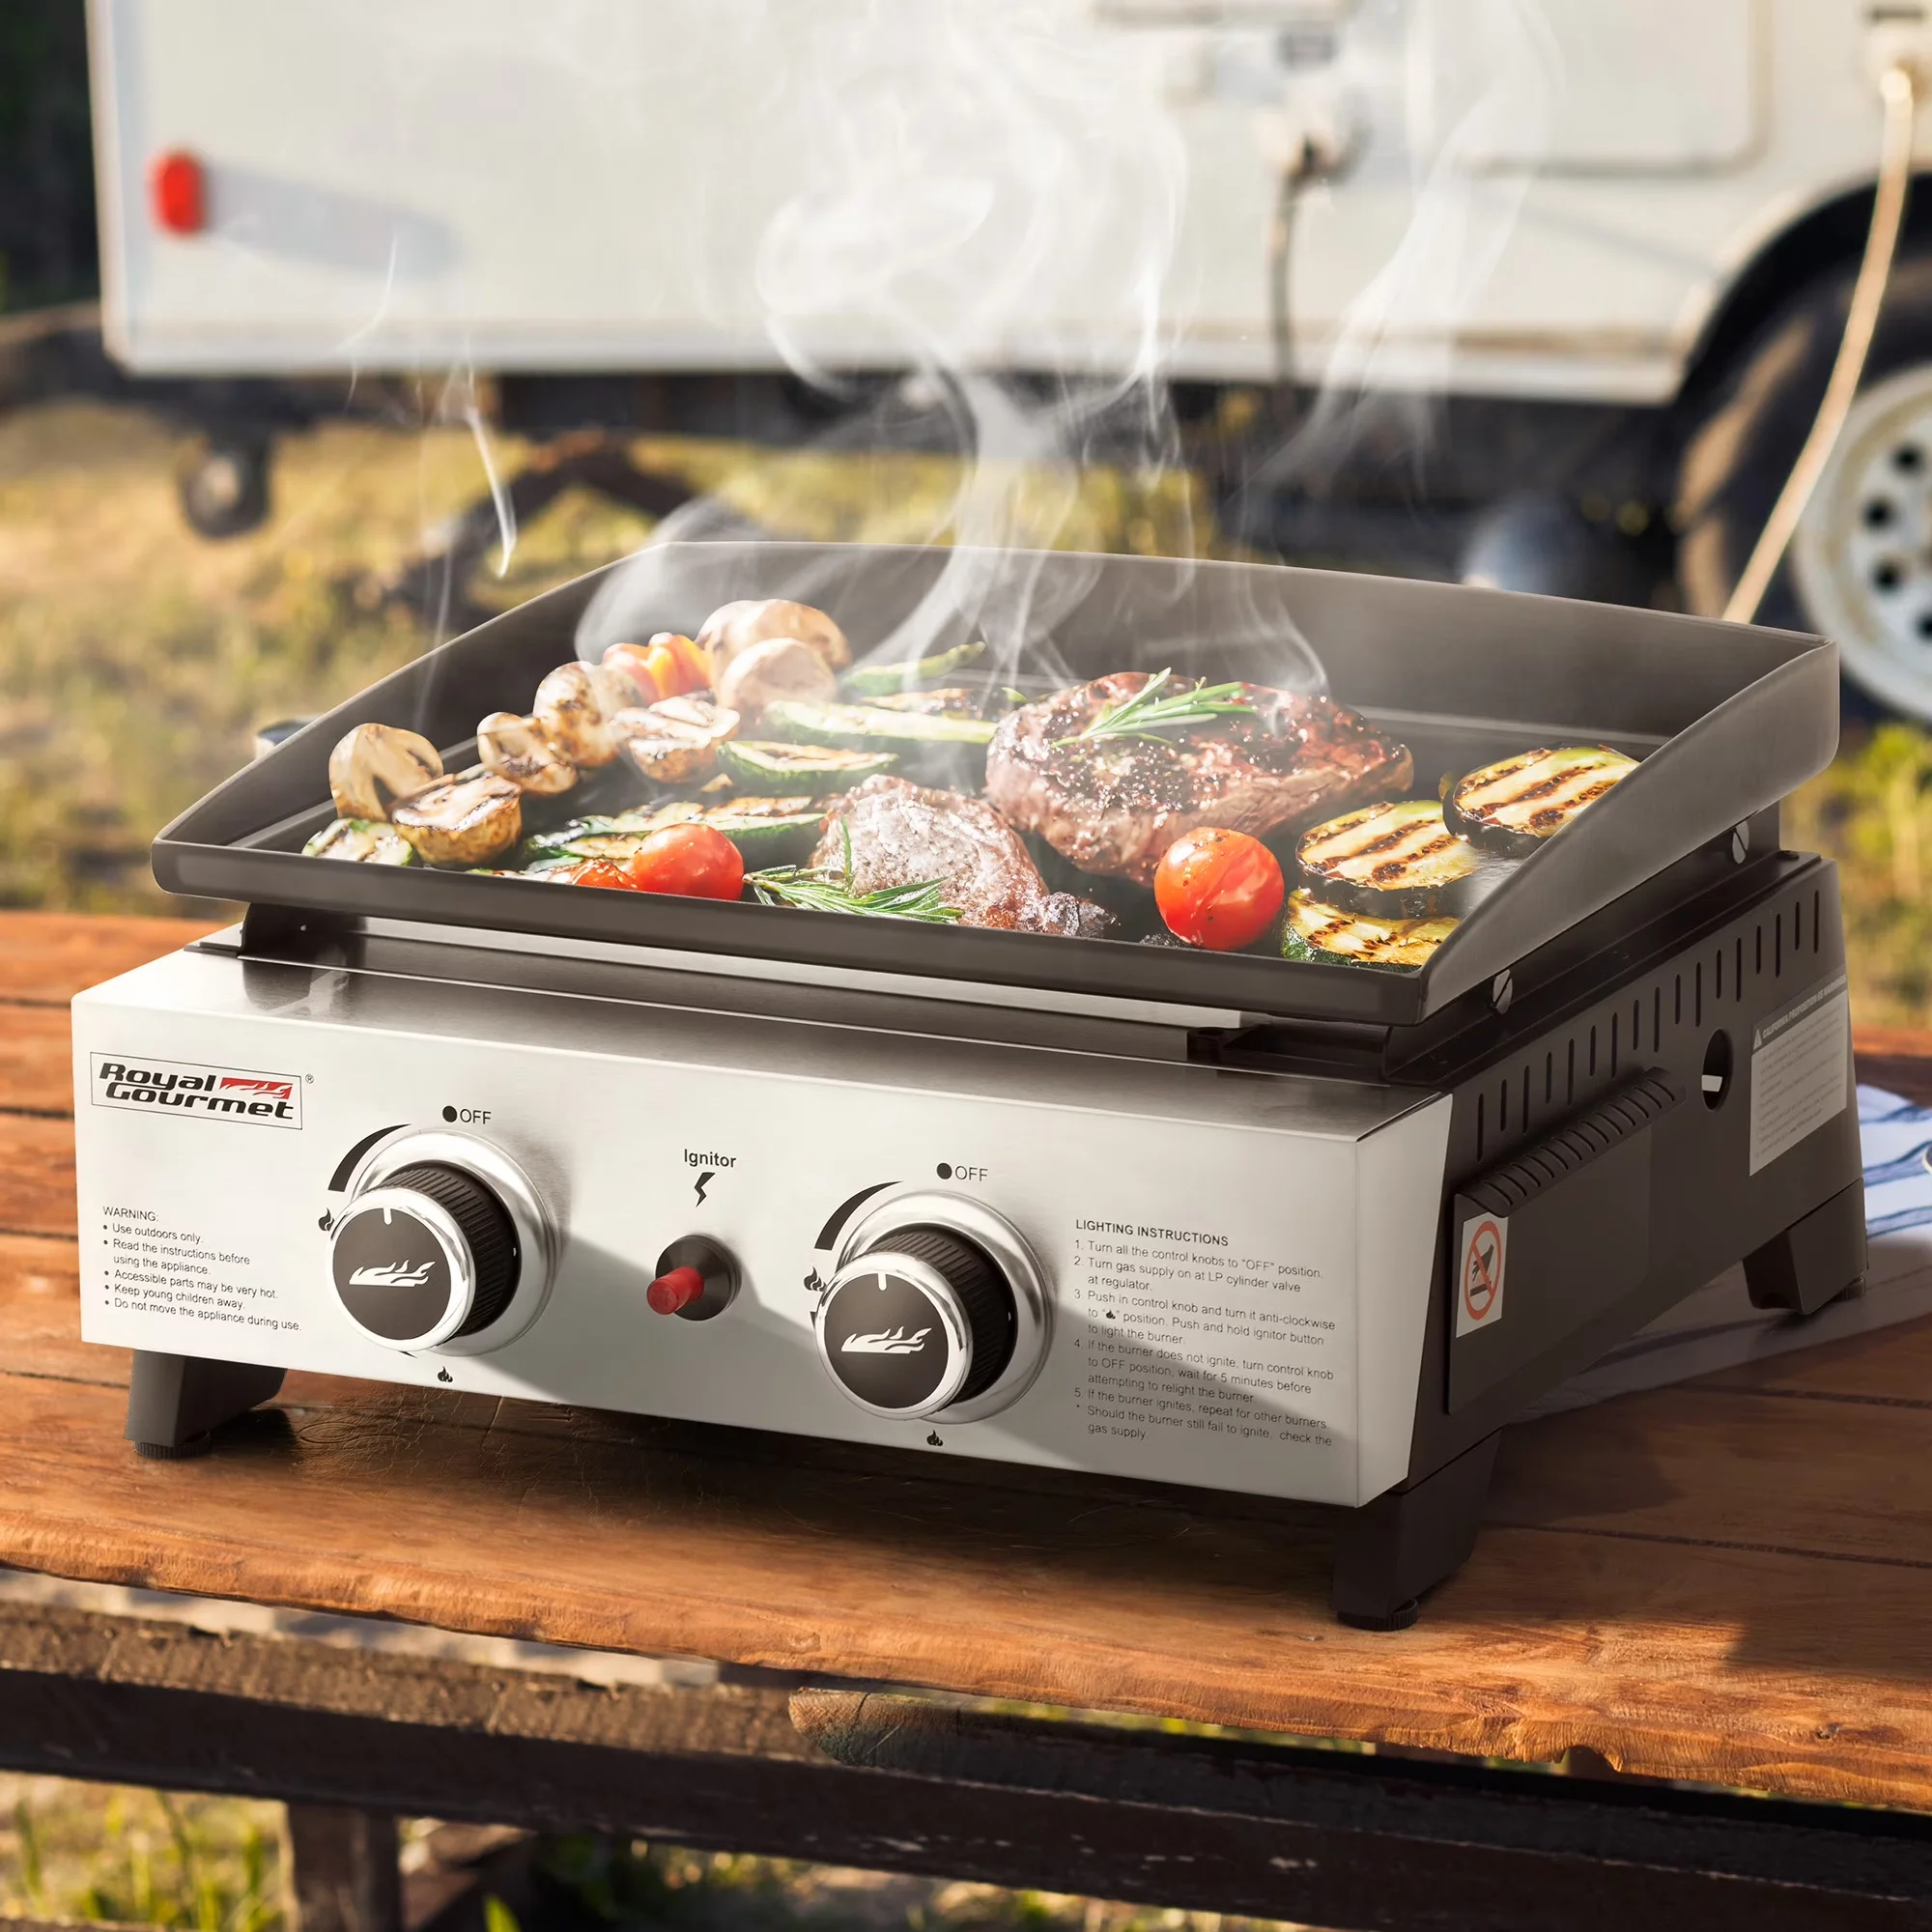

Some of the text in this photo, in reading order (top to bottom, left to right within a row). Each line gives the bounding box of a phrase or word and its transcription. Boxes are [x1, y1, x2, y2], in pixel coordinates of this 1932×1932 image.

[99, 1063, 216, 1092] Royal
[106, 1082, 294, 1120] Gourmet
[460, 1109, 492, 1124] OFF
[684, 1149, 736, 1168] Ignitor
[954, 1165, 988, 1181] OFF
[102, 1207, 158, 1221] WARNING:
[112, 1223, 203, 1244] Use outdoors only.
[1076, 1219, 1229, 1246] LIGHTING INSTRUCTIONS
[113, 1238, 250, 1264] Read the instructions before
[1088, 1240, 1113, 1253] Turn
[1117, 1244, 1128, 1255] all
[1132, 1246, 1148, 1257] the
[1152, 1250, 1188, 1262] control
[1192, 1253, 1225, 1266] knobs
[1228, 1258, 1237, 1267] to
[1242, 1259, 1275, 1271] "OFF"
[1278, 1264, 1322, 1278] position.
[113, 1256, 211, 1275] using the appliance.
[1088, 1257, 1113, 1269] Turn
[1116, 1263, 1135, 1273] gas
[1140, 1265, 1175, 1279] supply
[1178, 1269, 1191, 1279] on
[1195, 1271, 1205, 1281] at
[1208, 1271, 1223, 1282] LP
[1227, 1275, 1268, 1287] cylinder
[1272, 1281, 1300, 1293] valve
[114, 1269, 278, 1298] Accessible parts may be very hot.
[1088, 1275, 1152, 1292] at regulator.
[114, 1284, 245, 1311] Keep young children away.
[1088, 1290, 1115, 1303] Push
[1119, 1293, 1128, 1304] in
[1132, 1298, 1168, 1309] control
[1172, 1301, 1198, 1313] knob
[1202, 1306, 1221, 1316] and
[1225, 1308, 1246, 1319] turn
[1250, 1310, 1256, 1321] it
[1260, 1313, 1335, 1330] anti-clockwise
[114, 1298, 301, 1331] Do not move the appliance during use.
[1088, 1308, 1324, 1345] to position. Push and hold ignitor button
[1088, 1324, 1186, 1345] to light the burner.
[1088, 1340, 1095, 1350] If
[1097, 1341, 1115, 1352] the
[1118, 1345, 1153, 1357] burner
[1156, 1349, 1183, 1361] does
[1186, 1352, 1204, 1364] not
[1242, 1360, 1264, 1371] turn
[1267, 1364, 1304, 1376] control
[1307, 1367, 1333, 1379] knob
[1088, 1357, 1098, 1367] to
[1101, 1358, 1125, 1369] OFF
[1179, 1369, 1200, 1379] wait
[1203, 1370, 1217, 1381] for
[1221, 1373, 1228, 1383] 5
[1231, 1376, 1273, 1389] minutes
[1277, 1380, 1312, 1394] before
[1088, 1374, 1145, 1391] attempting
[1149, 1381, 1158, 1391] to
[1162, 1383, 1198, 1396] relight
[1199, 1387, 1215, 1398] the
[1088, 1389, 1095, 1399] If
[1097, 1391, 1115, 1402] the
[1118, 1393, 1153, 1406] burner
[1199, 1405, 1233, 1416] repeat
[1236, 1407, 1251, 1418] for
[1254, 1410, 1282, 1422] other
[1088, 1406, 1124, 1420] Should
[1128, 1411, 1145, 1422] the
[1149, 1414, 1183, 1427] burner
[1187, 1418, 1205, 1429] still
[1208, 1420, 1223, 1432] fail
[1227, 1424, 1236, 1434] to
[1279, 1431, 1311, 1444] check
[1315, 1435, 1331, 1446] the
[1088, 1423, 1107, 1434] gas
